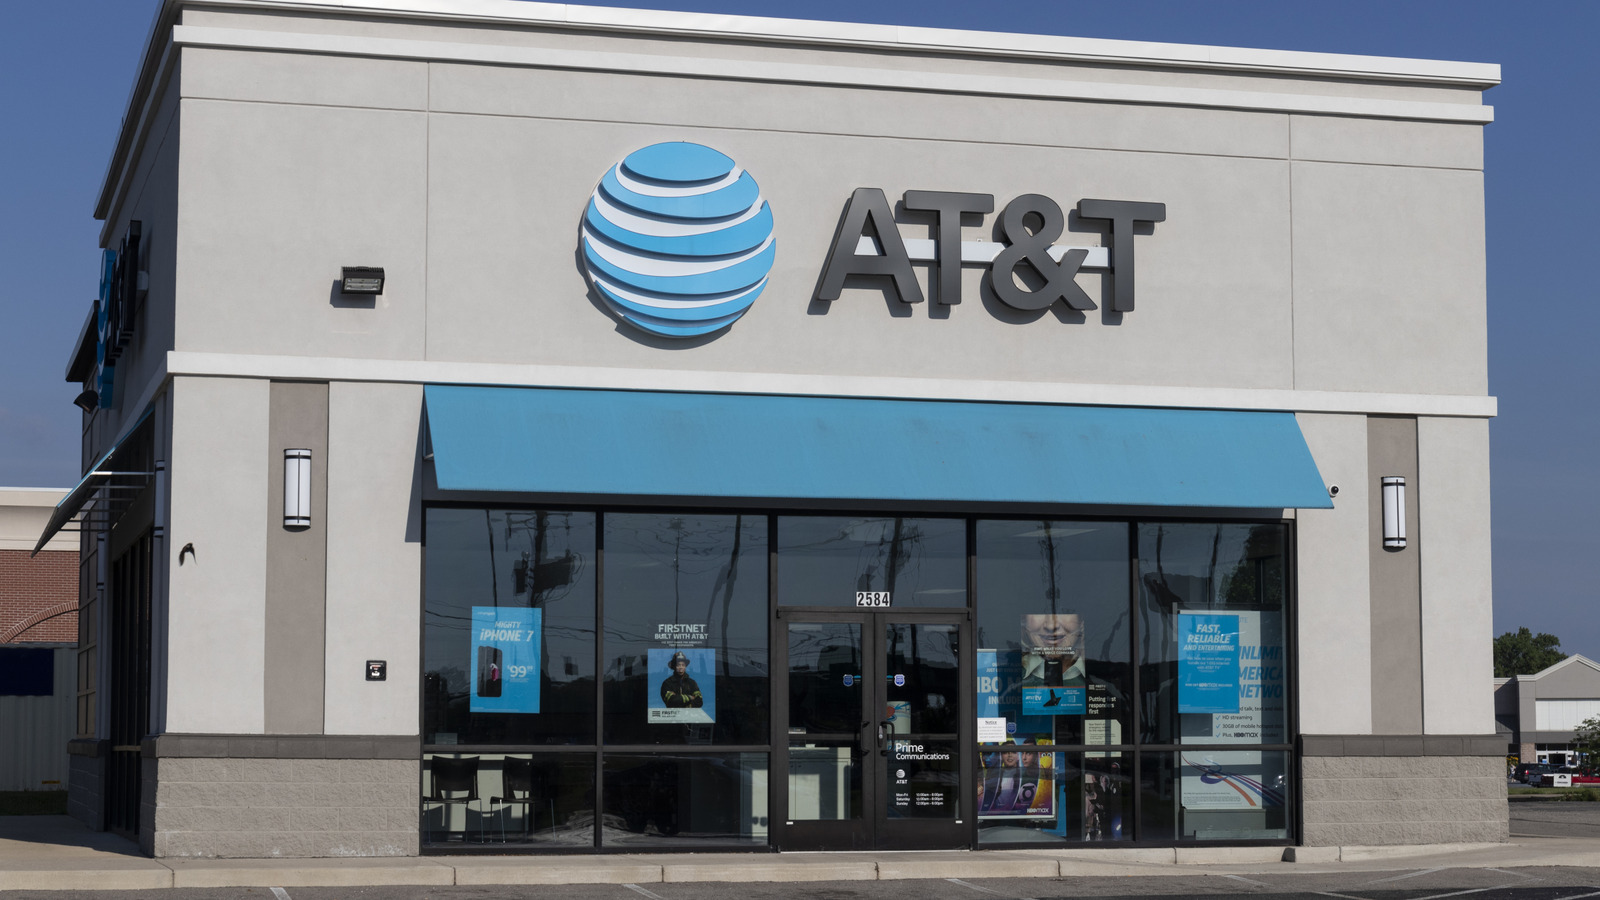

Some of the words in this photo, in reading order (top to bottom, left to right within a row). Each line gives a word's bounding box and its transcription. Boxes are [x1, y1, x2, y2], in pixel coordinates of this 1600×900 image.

[817, 187, 1166, 312] AT&T
[857, 592, 890, 607] 2584
[495, 621, 521, 629] MIGHTY
[658, 624, 706, 633] FIRSTNET
[1196, 624, 1221, 634] FAST,
[480, 629, 522, 641] iPHONE
[526, 630, 534, 642] 7
[1187, 634, 1231, 644] RELIABLE
[895, 743, 924, 752] Prime
